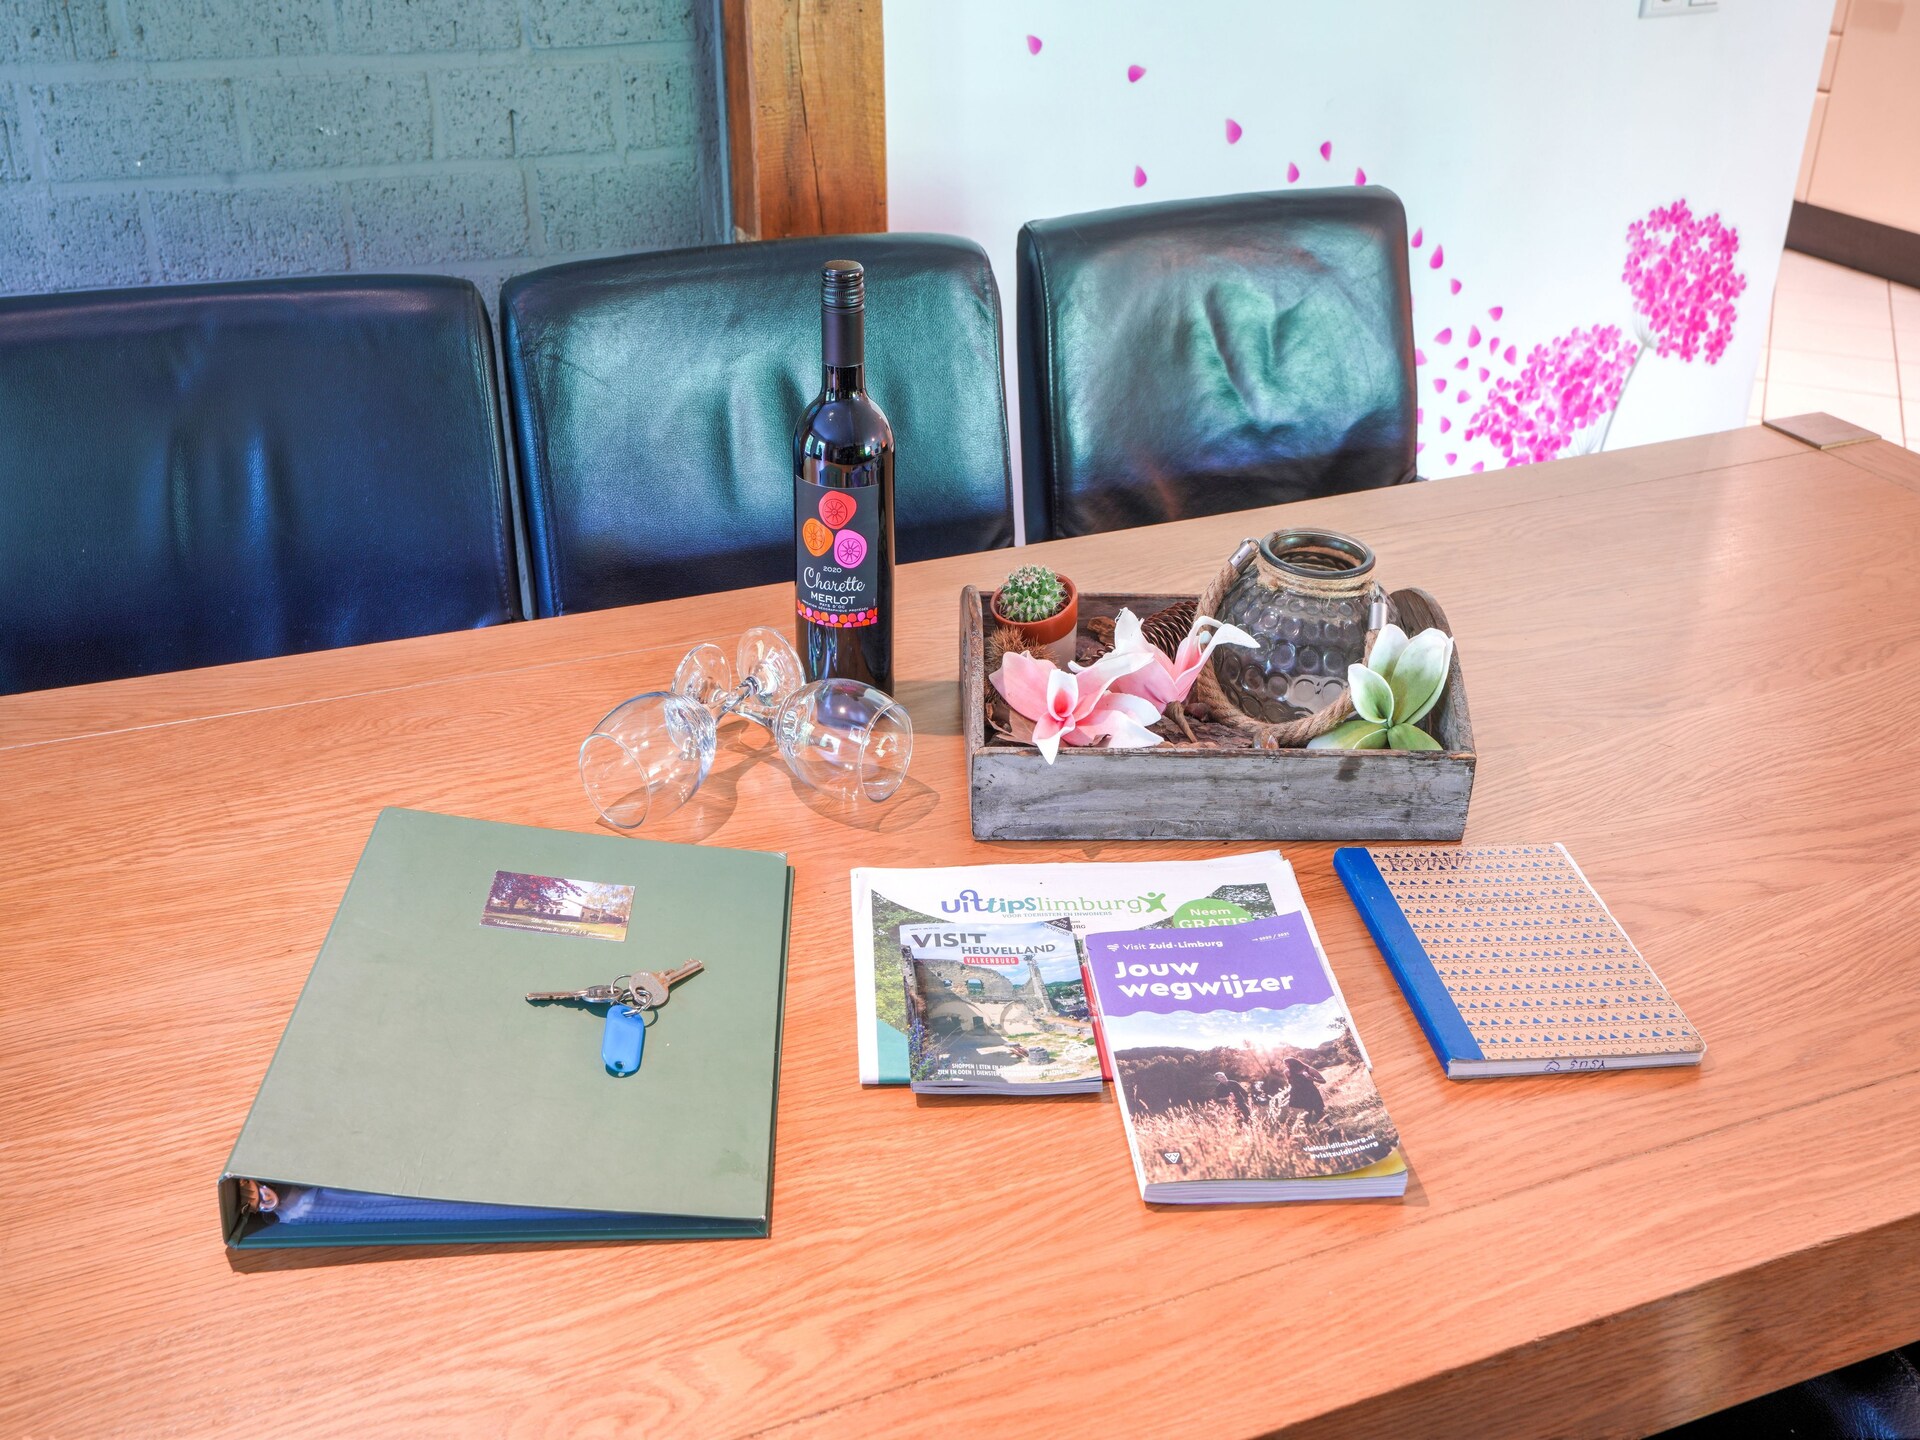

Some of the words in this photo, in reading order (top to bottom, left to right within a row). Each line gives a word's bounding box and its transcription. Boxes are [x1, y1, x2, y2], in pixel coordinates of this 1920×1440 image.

[823, 565, 842, 573] 2020
[803, 566, 866, 592] Charette
[810, 591, 856, 605] MERLOT
[1189, 908, 1231, 916] Neem
[911, 933, 987, 948] VISIT
[1122, 943, 1147, 951] Visit
[961, 944, 1056, 956] HEUVELLAND
[965, 956, 1017, 965] VALKENBURG
[1114, 961, 1200, 979] Jouw
[1117, 974, 1294, 1001] wegwijzer
[1302, 1133, 1376, 1152] visitzuidlimburg.nl
[1310, 1141, 1380, 1160] #visitzuidlimburg
